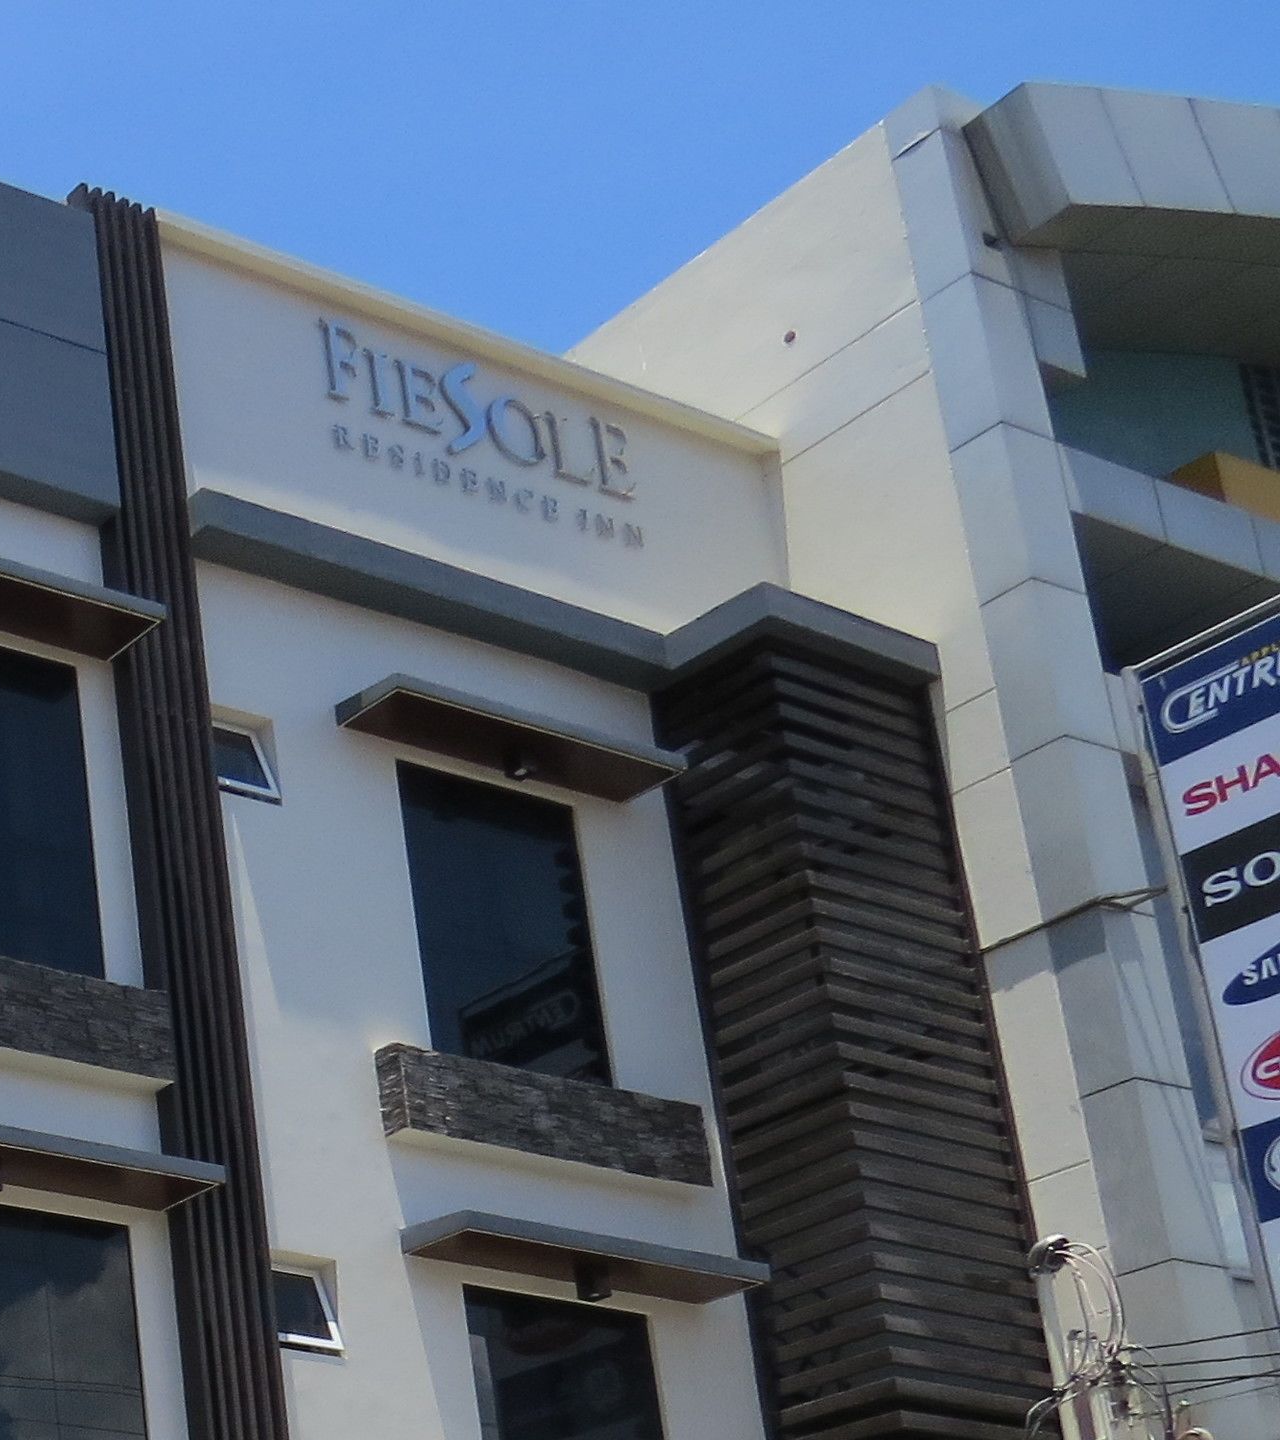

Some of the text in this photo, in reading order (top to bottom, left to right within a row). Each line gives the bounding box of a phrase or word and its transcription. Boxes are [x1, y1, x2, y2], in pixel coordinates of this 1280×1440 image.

[318, 316, 637, 500] FIESOLE
[331, 423, 645, 549] RESIDENCE INN
[1201, 850, 1280, 908] SO
[1242, 953, 1280, 986] SA
